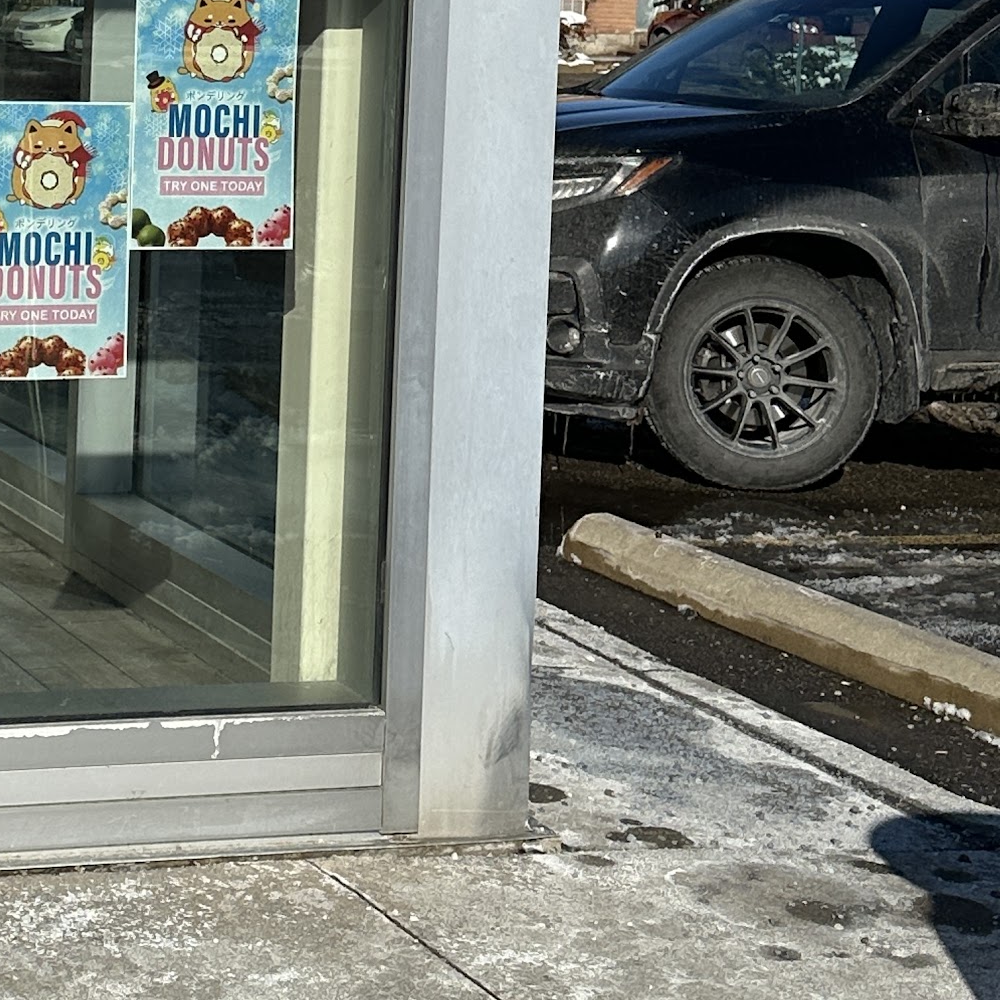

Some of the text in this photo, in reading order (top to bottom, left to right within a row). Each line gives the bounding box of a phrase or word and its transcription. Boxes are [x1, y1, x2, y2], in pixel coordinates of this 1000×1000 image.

[186, 90, 245, 102] ポンデリング
[168, 103, 260, 138] MOCHI
[157, 137, 269, 172] DONUTS
[163, 180, 262, 192] TRY ONE TODAY
[14, 218, 76, 229] ポンデリング
[20, 309, 48, 321] ONE
[51, 308, 95, 321] TODAY
